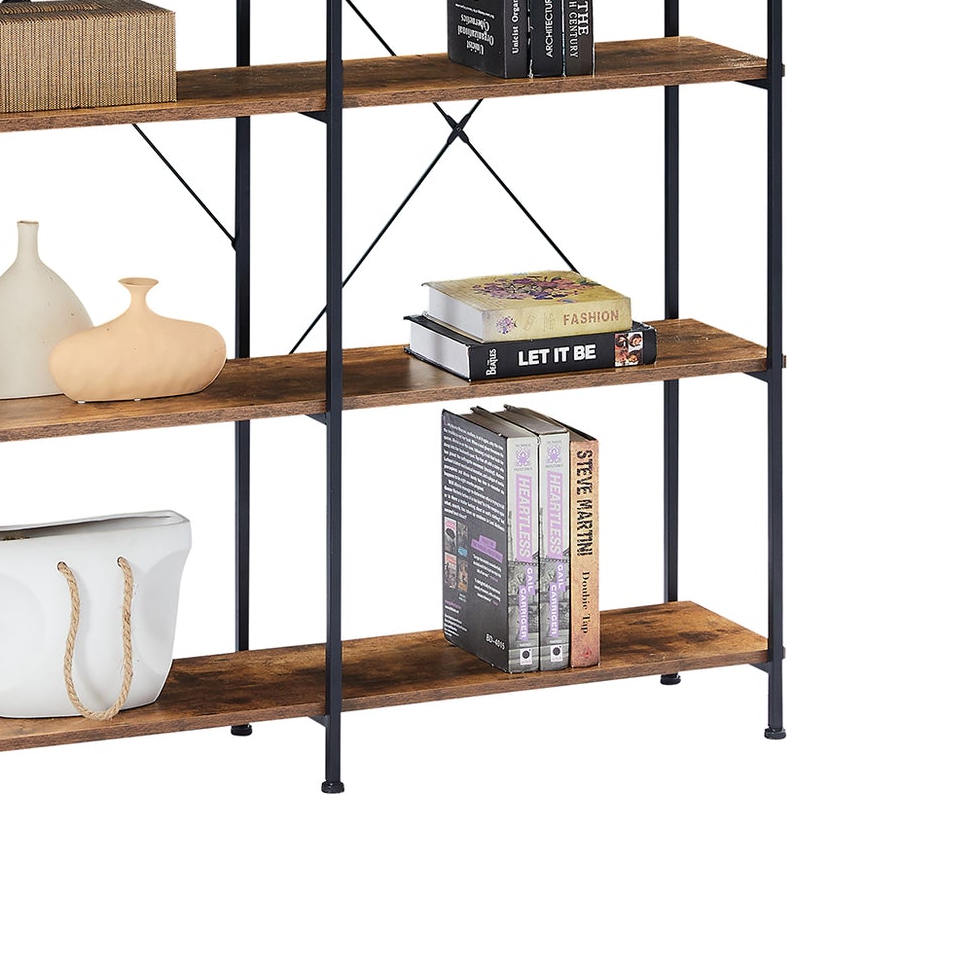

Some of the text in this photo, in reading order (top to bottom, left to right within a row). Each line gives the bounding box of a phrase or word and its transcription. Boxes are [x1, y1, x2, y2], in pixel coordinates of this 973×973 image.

[570, 11, 579, 58] CENTURY
[578, 0, 589, 36] THE
[511, 26, 519, 54] Unicist
[563, 310, 619, 326] FASHION
[518, 344, 596, 366] LET IT BE
[577, 450, 593, 495] STEVE
[518, 478, 532, 558] HEARTLESS
[548, 473, 562, 554] HEARTLESS
[581, 614, 591, 634] Tap
